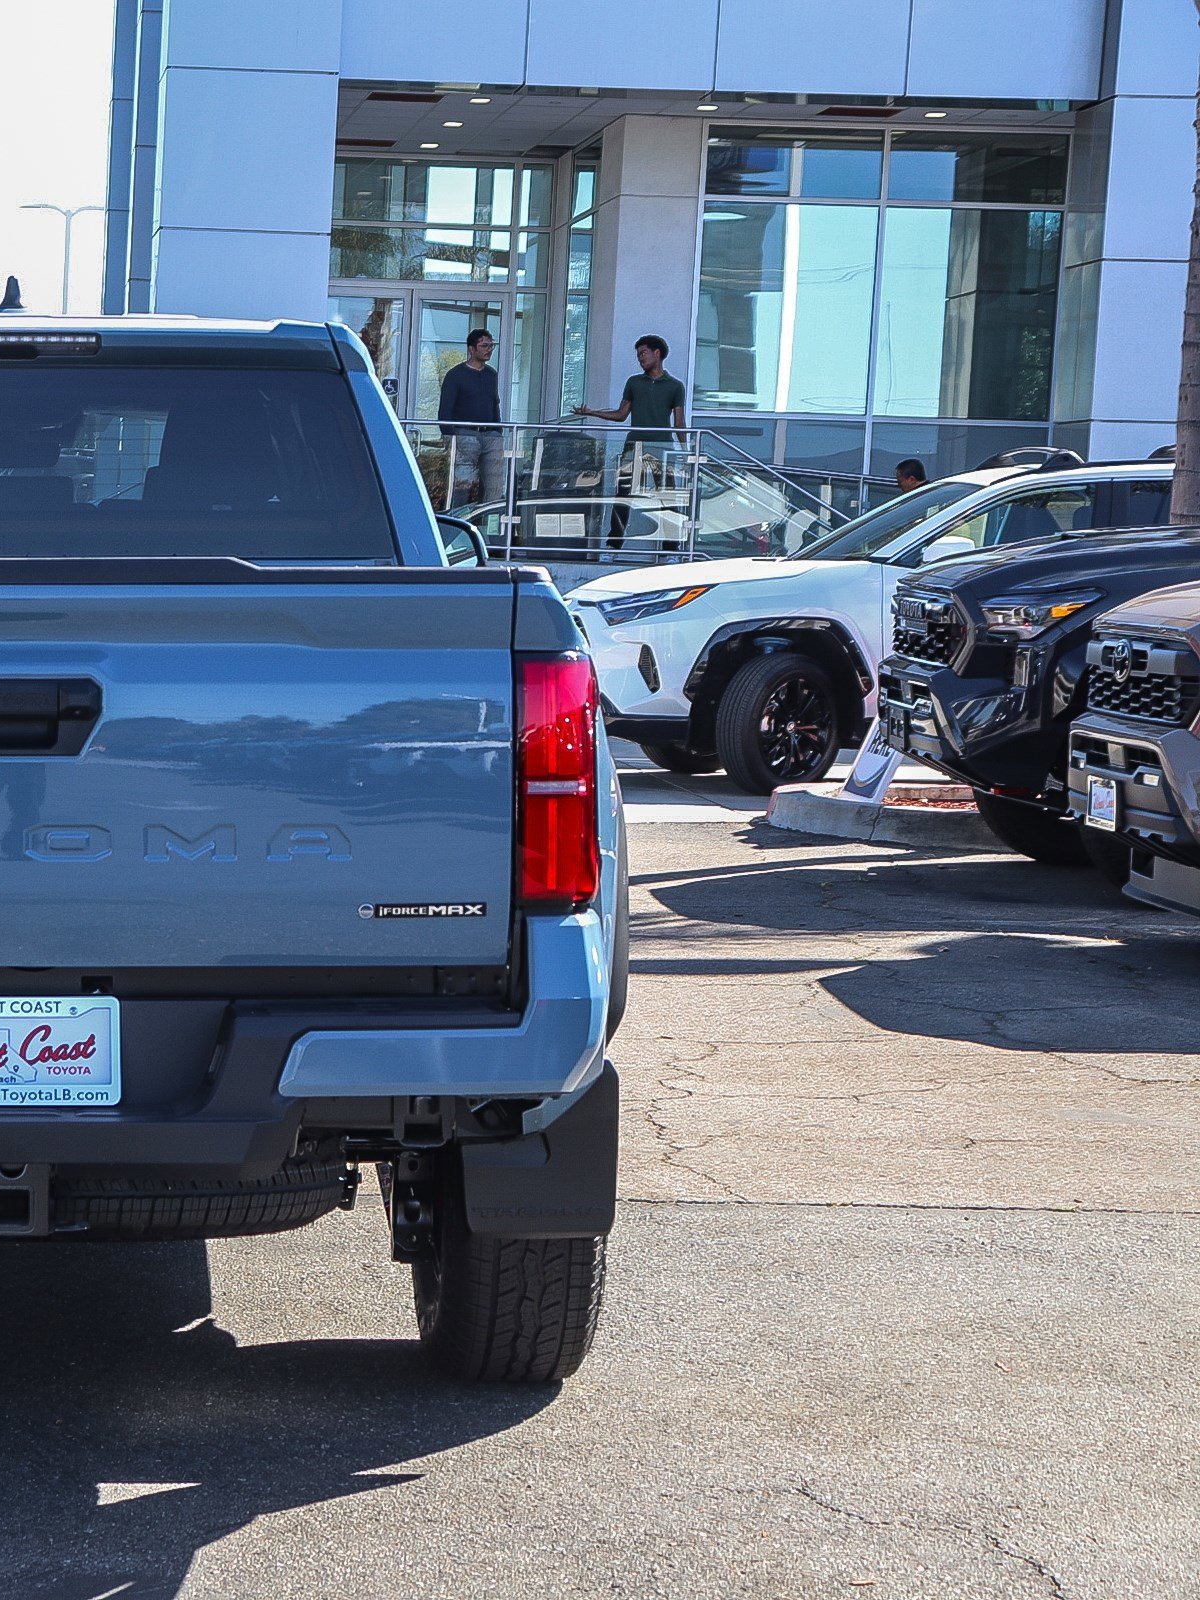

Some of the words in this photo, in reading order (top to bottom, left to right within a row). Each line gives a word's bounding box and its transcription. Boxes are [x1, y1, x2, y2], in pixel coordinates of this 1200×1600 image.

[10, 1001, 62, 1014] COAST
[19, 1024, 96, 1066] Coast
[46, 1066, 91, 1075] TOYOTA
